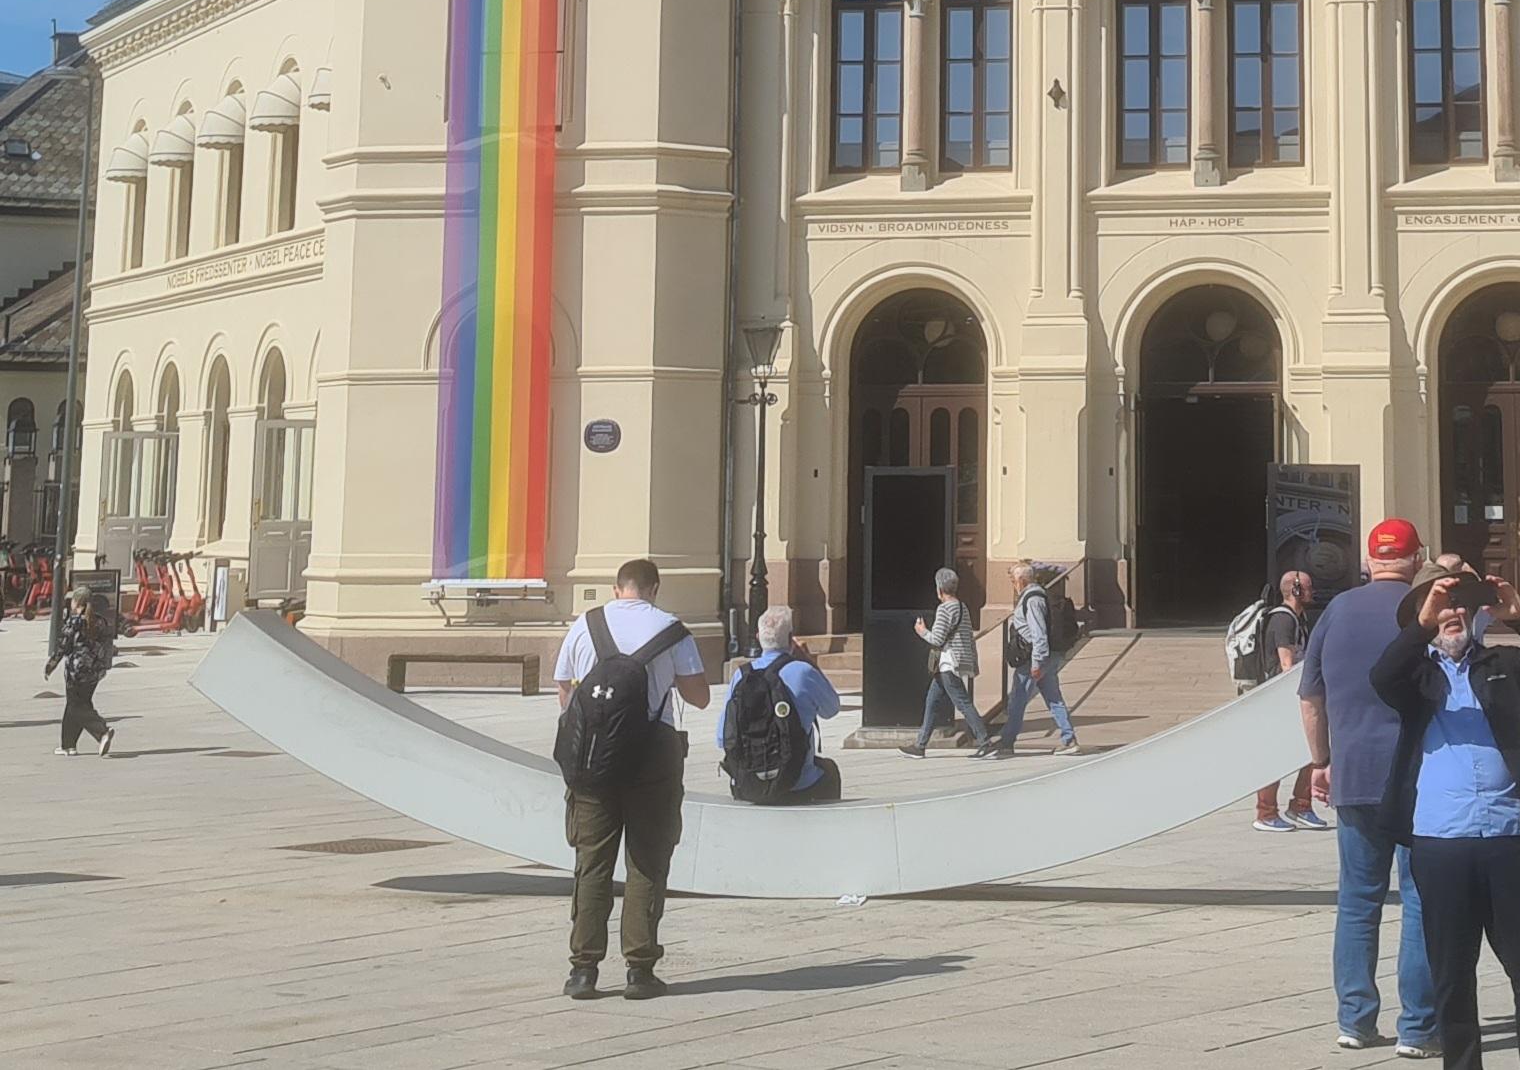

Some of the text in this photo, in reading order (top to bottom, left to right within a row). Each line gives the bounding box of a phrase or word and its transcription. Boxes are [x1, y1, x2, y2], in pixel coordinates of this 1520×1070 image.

[1208, 217, 1245, 227] HOPE
[1404, 214, 1507, 225] ENGASJEMENT
[817, 220, 1010, 234] VIDSYN BROADMINDEDNESS
[166, 269, 194, 290] NOBELS
[195, 257, 248, 283] FREDSSENTER
[254, 249, 283, 270] NOBEL
[283, 239, 312, 266] PEACE
